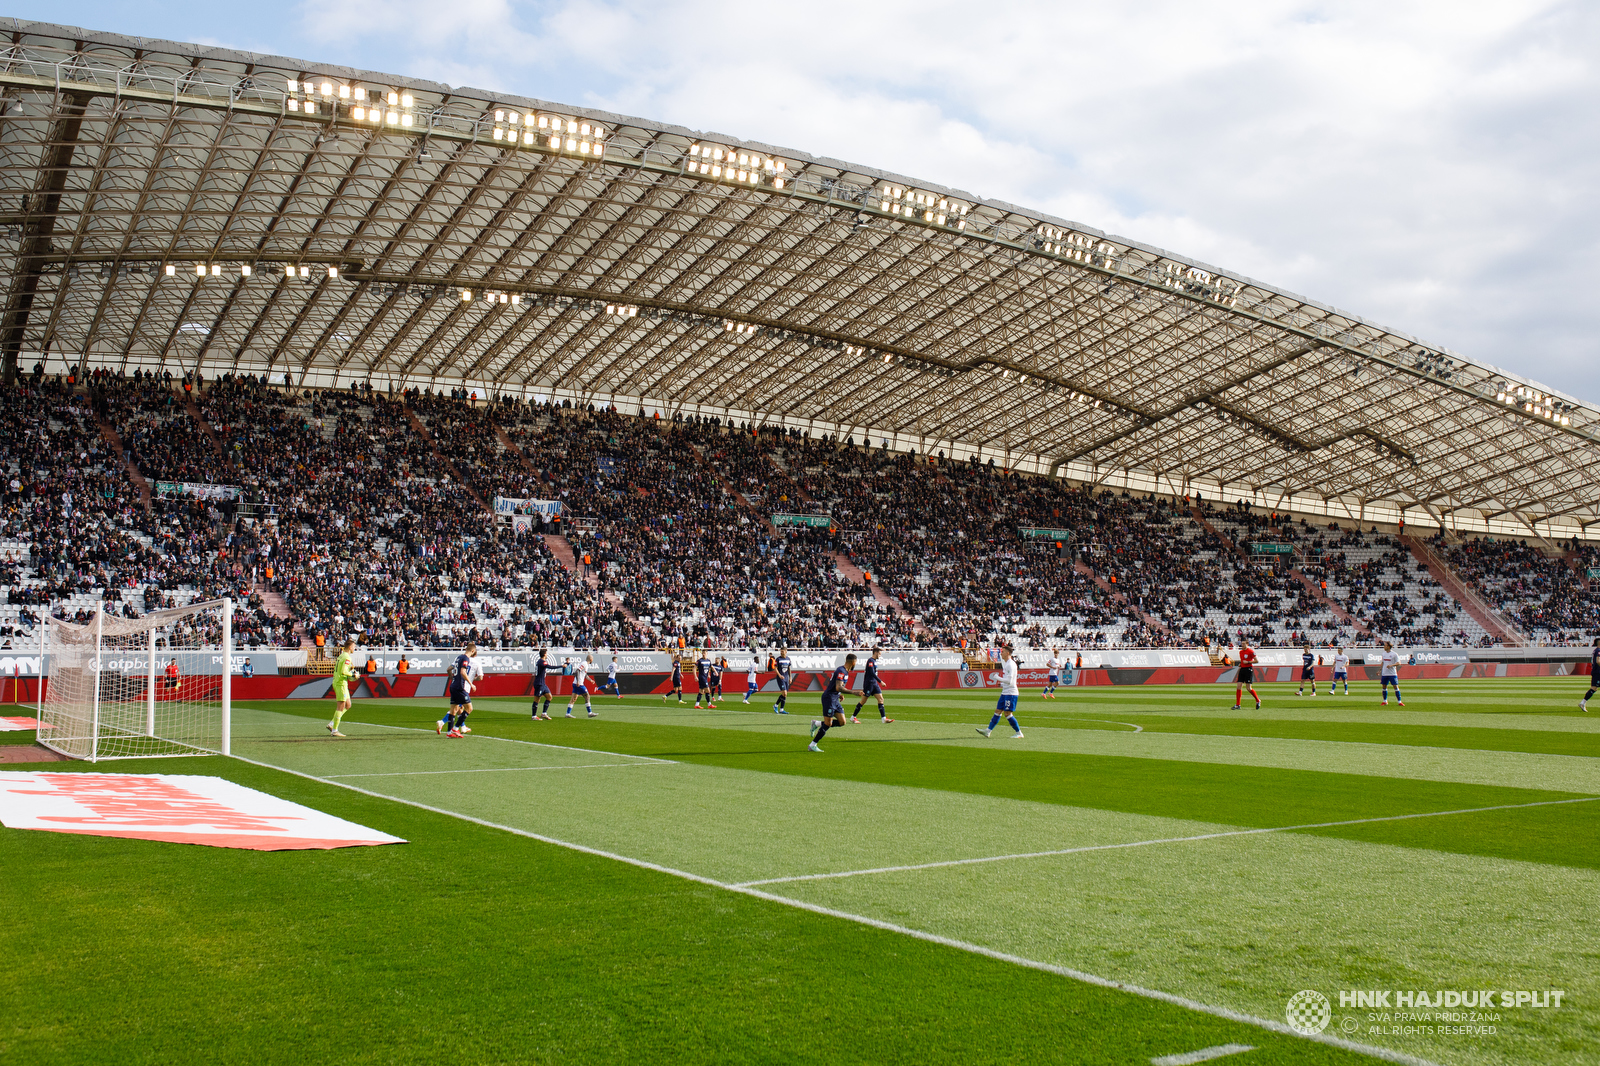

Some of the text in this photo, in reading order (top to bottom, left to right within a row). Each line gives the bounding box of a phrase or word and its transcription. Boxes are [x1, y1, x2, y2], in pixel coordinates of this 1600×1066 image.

[789, 655, 838, 669] TOMMY
[921, 656, 961, 666] otpbanka
[1172, 654, 1206, 664] LUKOIL
[1417, 653, 1440, 662] OlyBet
